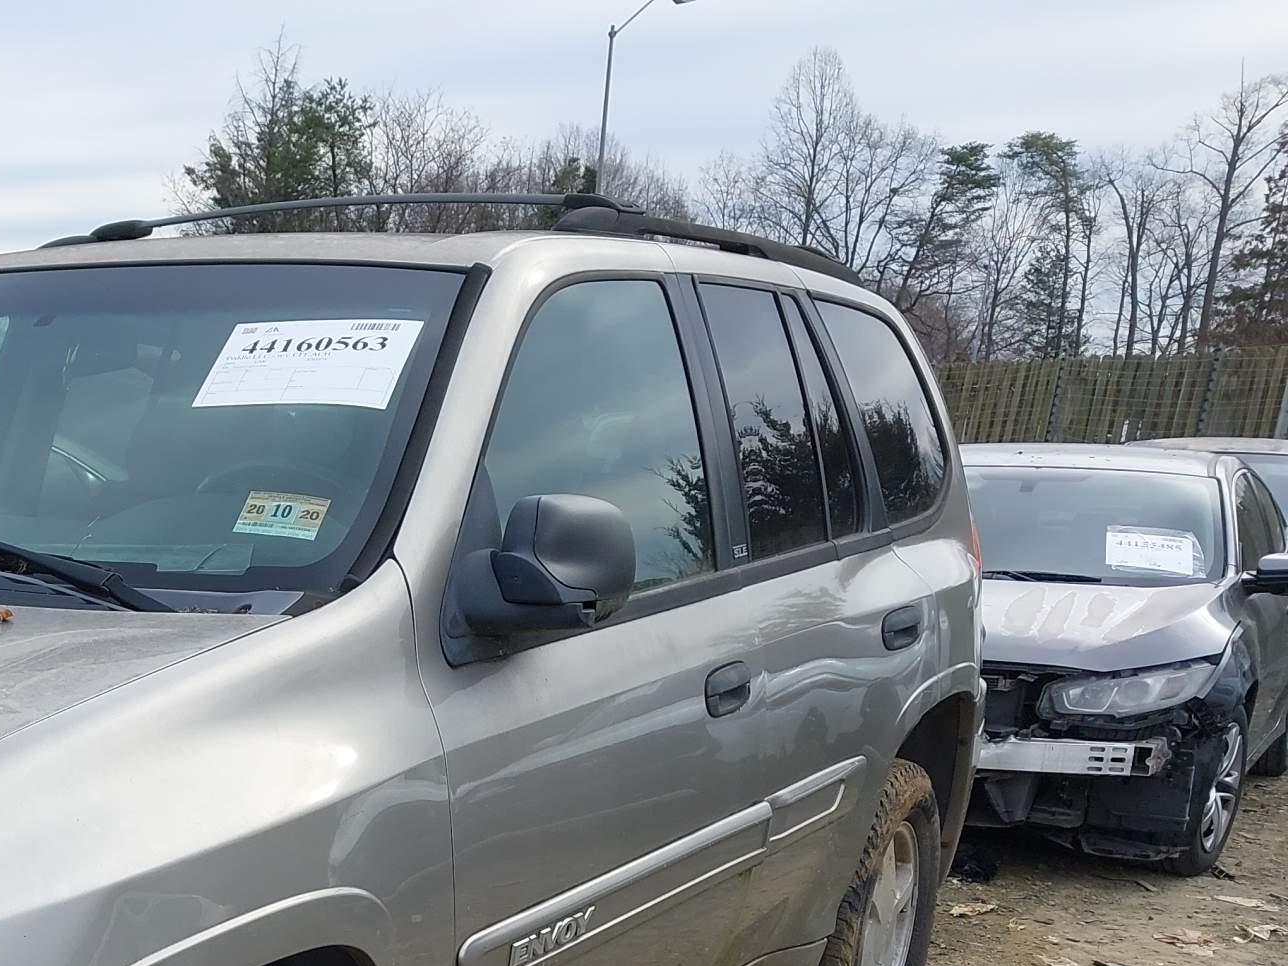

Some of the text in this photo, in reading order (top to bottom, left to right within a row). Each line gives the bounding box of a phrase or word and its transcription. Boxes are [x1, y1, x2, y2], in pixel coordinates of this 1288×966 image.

[241, 335, 390, 355] 44160563
[245, 503, 320, 521] 20 10 20
[733, 546, 749, 559] SLE
